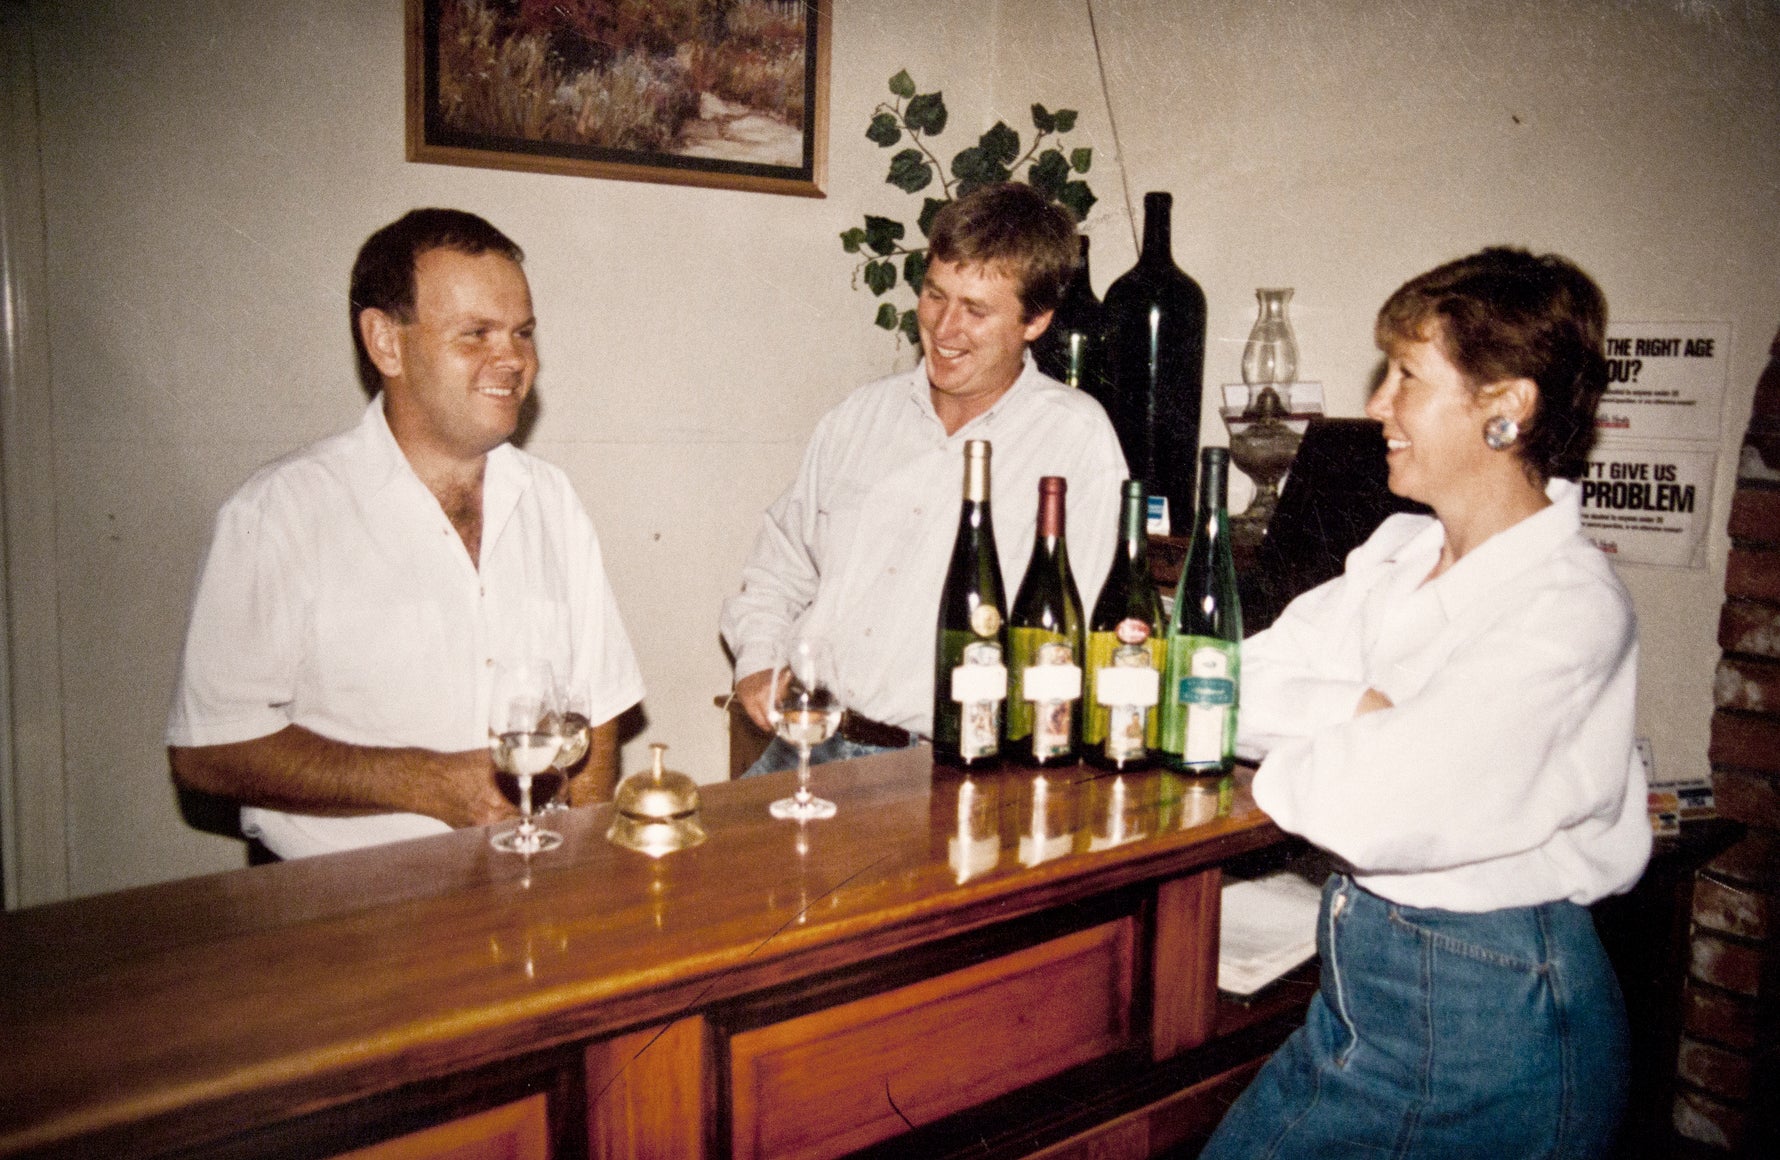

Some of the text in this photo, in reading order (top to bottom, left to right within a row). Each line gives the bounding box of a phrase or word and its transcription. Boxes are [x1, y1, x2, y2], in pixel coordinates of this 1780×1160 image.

[1607, 338, 1715, 358] THE RIGHT AGE
[1606, 359, 1642, 383] OU?
[1581, 461, 1677, 482] N'T GIVE US
[1581, 481, 1696, 514] PROBLEM
